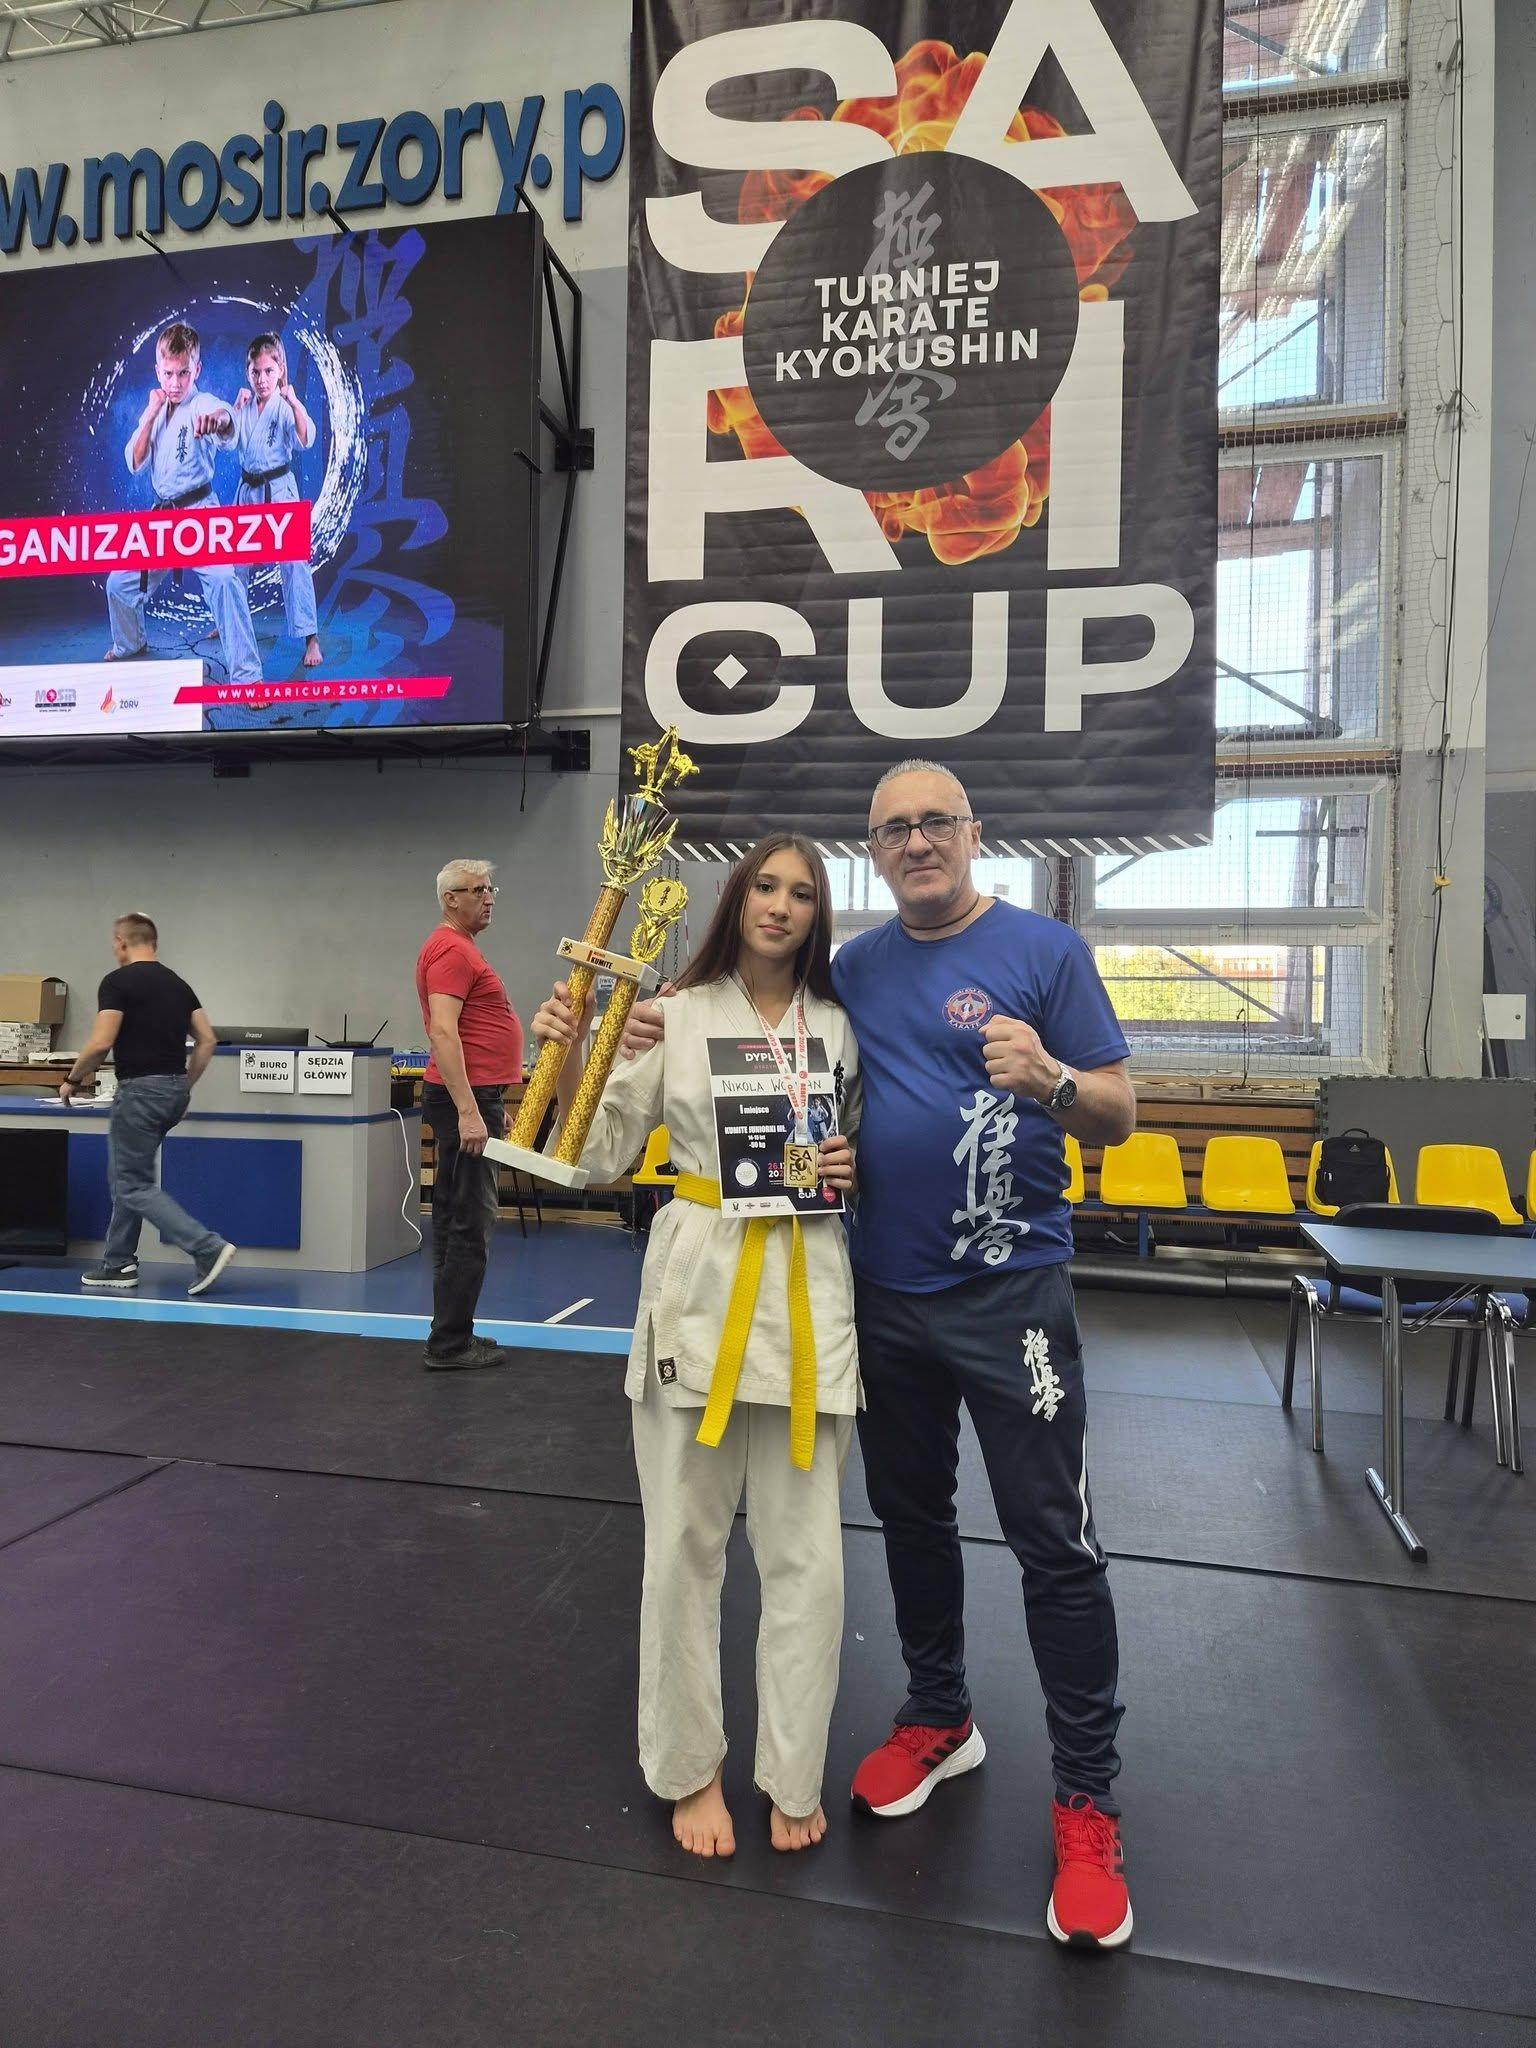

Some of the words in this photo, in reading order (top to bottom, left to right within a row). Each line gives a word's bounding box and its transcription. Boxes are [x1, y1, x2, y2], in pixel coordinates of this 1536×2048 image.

[814, 260, 1000, 308] TURNIEJ
[821, 296, 988, 343] KARATE
[775, 328, 1039, 382] KYOKUSHIN
[644, 583, 1195, 745] CUP
[217, 684, 405, 700] WWW.SARICUP.ZORY.PL
[591, 956, 613, 970] KUMITE
[307, 1057, 344, 1067] SĘDZIA
[745, 1052, 793, 1062] DYPLM
[259, 1061, 287, 1069] BIURO
[245, 1072, 289, 1080] TURNIEJU
[303, 1070, 347, 1080] GŁÓWNY
[721, 1079, 765, 1093] NIKOLA
